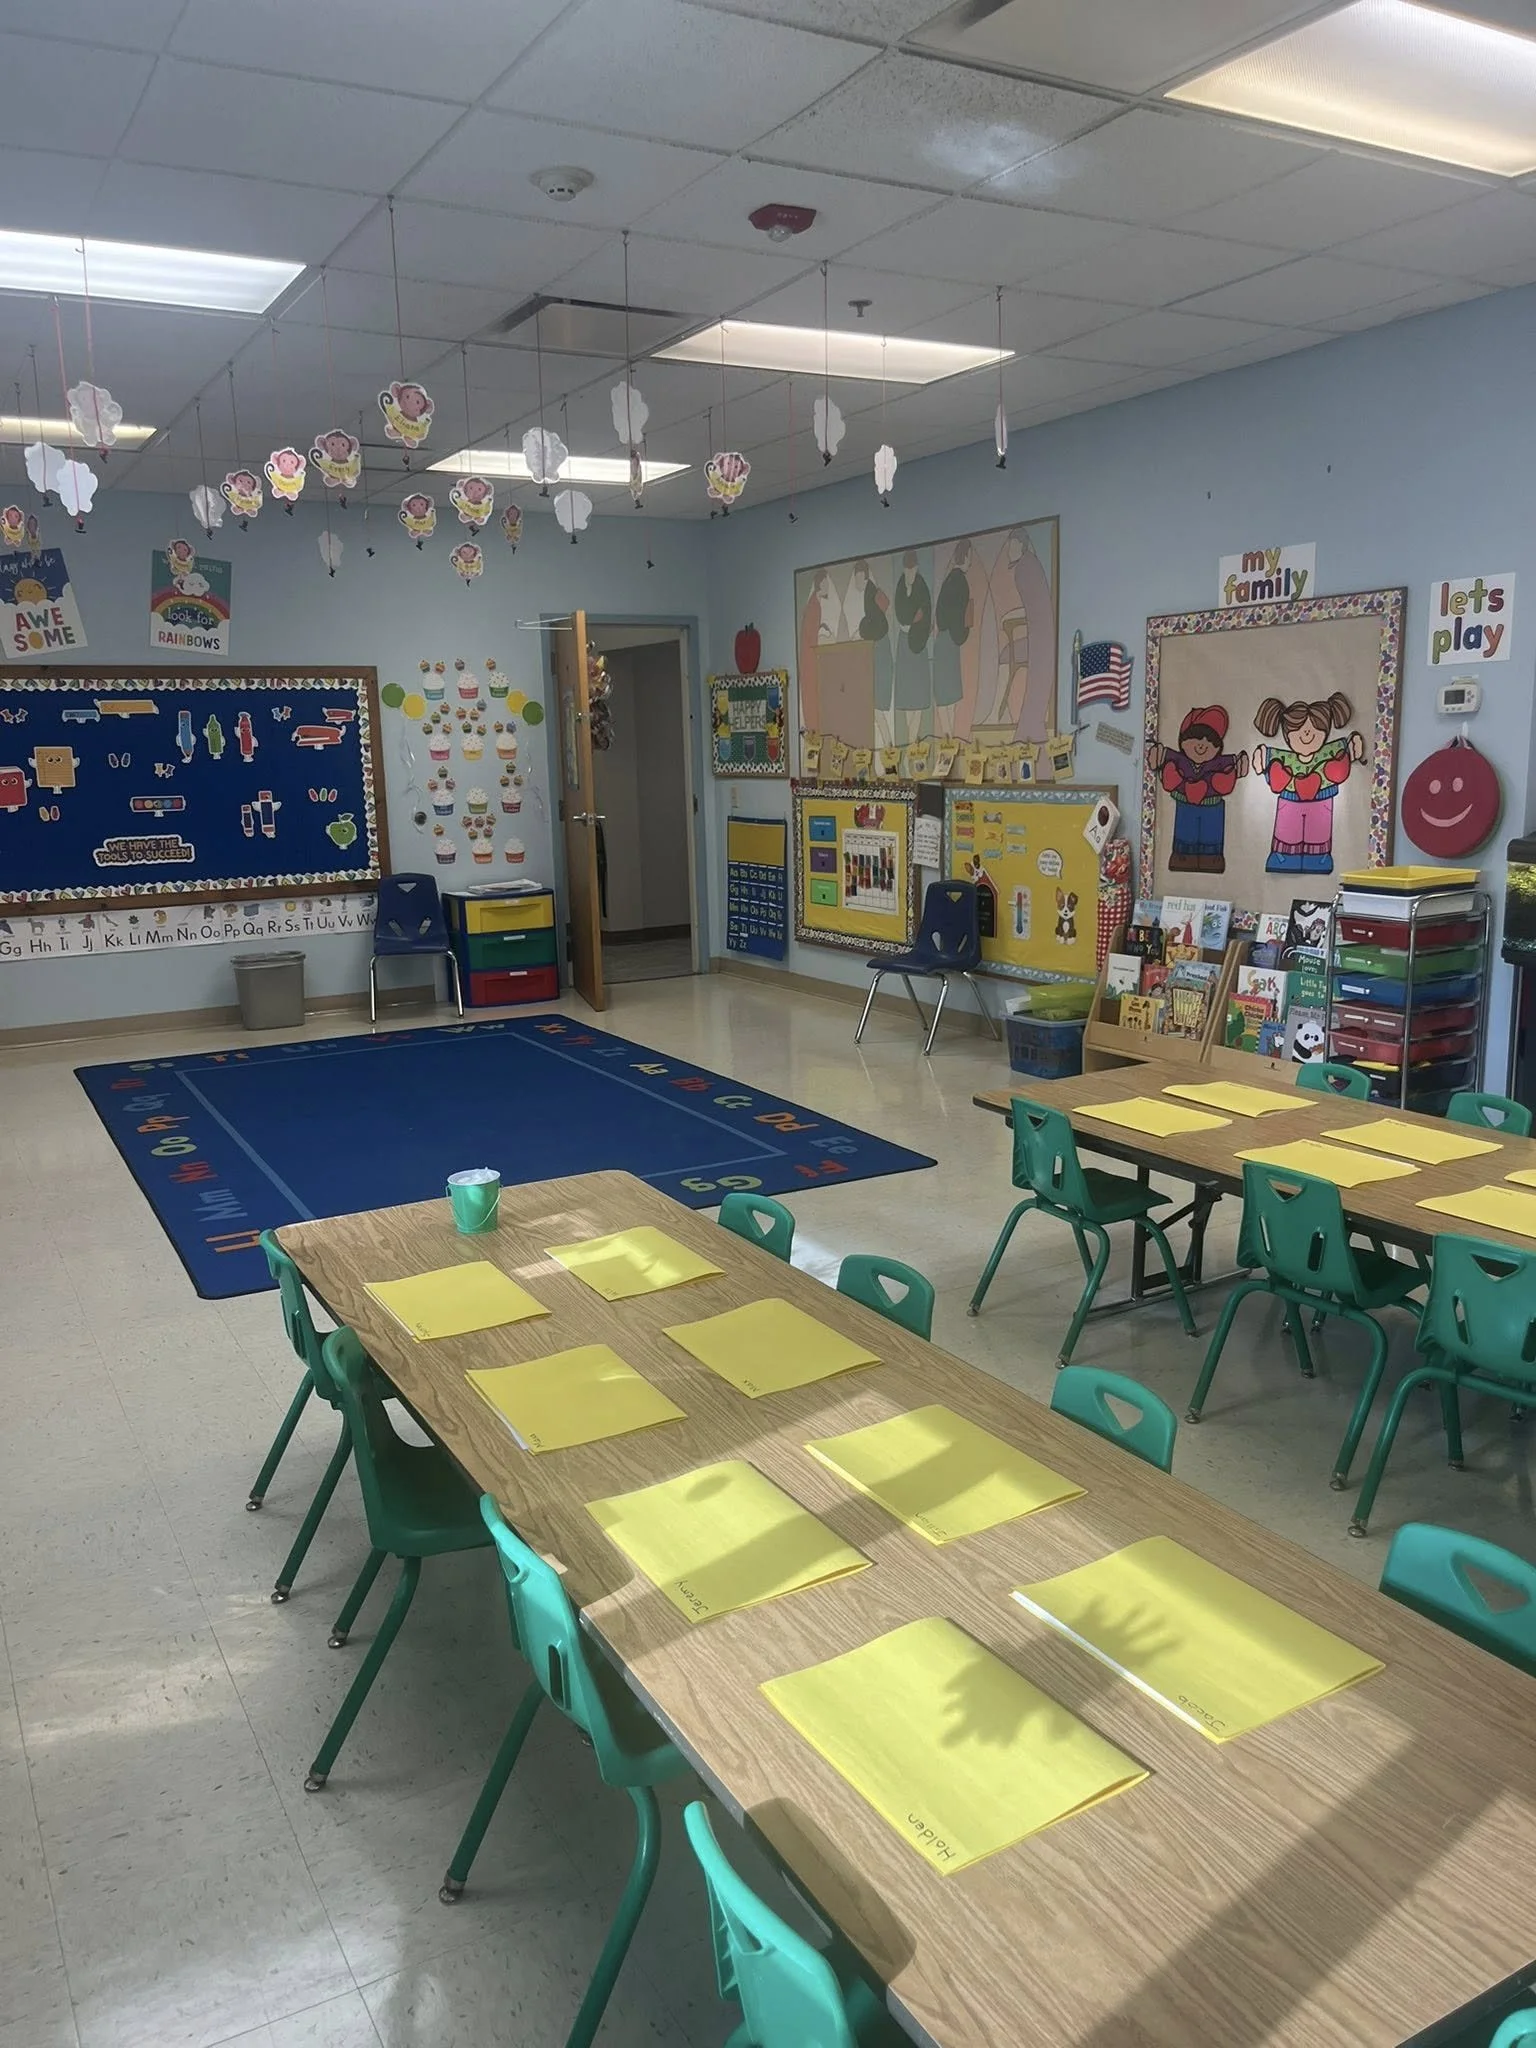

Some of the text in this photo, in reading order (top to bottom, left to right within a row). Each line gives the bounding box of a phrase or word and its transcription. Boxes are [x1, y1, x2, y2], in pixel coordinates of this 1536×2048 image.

[1242, 546, 1281, 577] my
[1223, 568, 1308, 605] family
[1440, 578, 1504, 617] lets
[16, 607, 64, 632] AWE
[168, 607, 215, 625] look for
[14, 626, 76, 652] SOME
[158, 631, 220, 650] RAINBOWS
[1432, 616, 1504, 664] play
[99, 851, 128, 862] TOOLS
[132, 851, 142, 860] TO
[108, 838, 178, 851] WE HAVE THE
[0, 941, 21, 957] Gg
[30, 938, 51, 953] Hh
[60, 937, 69, 951] Ii
[82, 935, 93, 952] Jj
[104, 933, 124, 947] Kk
[129, 932, 140, 946] Ll
[145, 930, 173, 944] Mm
[177, 927, 197, 941] Nn
[201, 925, 220, 939] Oo
[224, 923, 240, 938] Pp
[243, 922, 263, 936] Qq
[268, 920, 281, 933] Rr
[285, 919, 300, 932] Ss
[303, 917, 313, 930] Tt
[317, 916, 335, 929] Uu
[338, 915, 353, 928] Vv
[1266, 921, 1287, 938] ABC
[136, 1115, 191, 1133] Pp
[629, 1063, 669, 1075] Aa
[668, 1076, 717, 1092] Bb
[713, 1095, 753, 1110] Cc
[752, 1111, 821, 1133] Dd
[810, 1135, 859, 1155] Ee
[151, 1136, 198, 1156] Oo
[192, 1188, 248, 1222] Mm
[674, 1579, 709, 1616] Jeremy
[1177, 1694, 1226, 1732] Jacob
[907, 1812, 957, 1862] Holden
